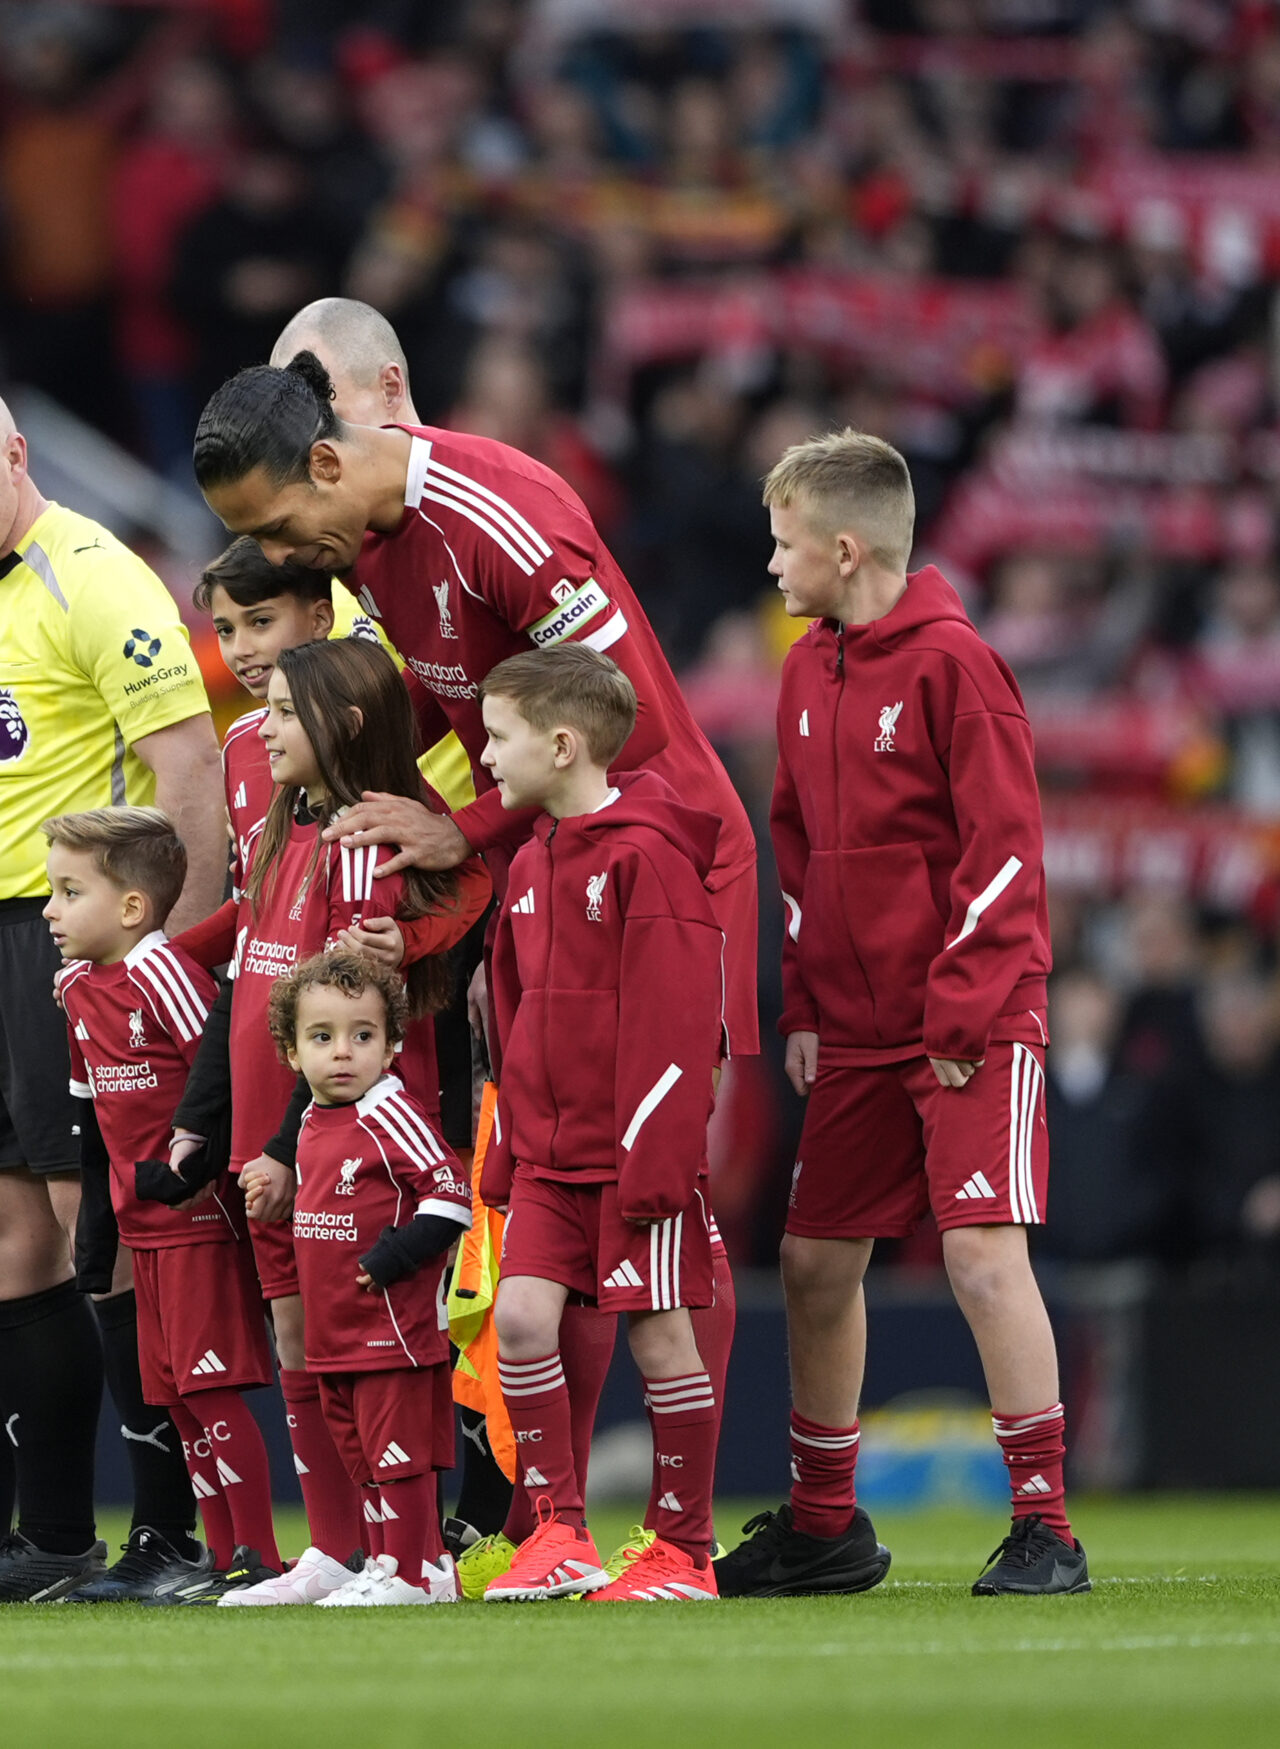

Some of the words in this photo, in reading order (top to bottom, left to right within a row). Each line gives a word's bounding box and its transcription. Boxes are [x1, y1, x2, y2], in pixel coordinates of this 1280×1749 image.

[534, 594, 598, 644] Captain
[123, 664, 188, 696] HuwsGray
[248, 937, 297, 962] standard
[95, 1060, 151, 1079] standard
[96, 1073, 159, 1093] chartered
[294, 1209, 355, 1228] standard
[293, 1225, 359, 1242] chartered
